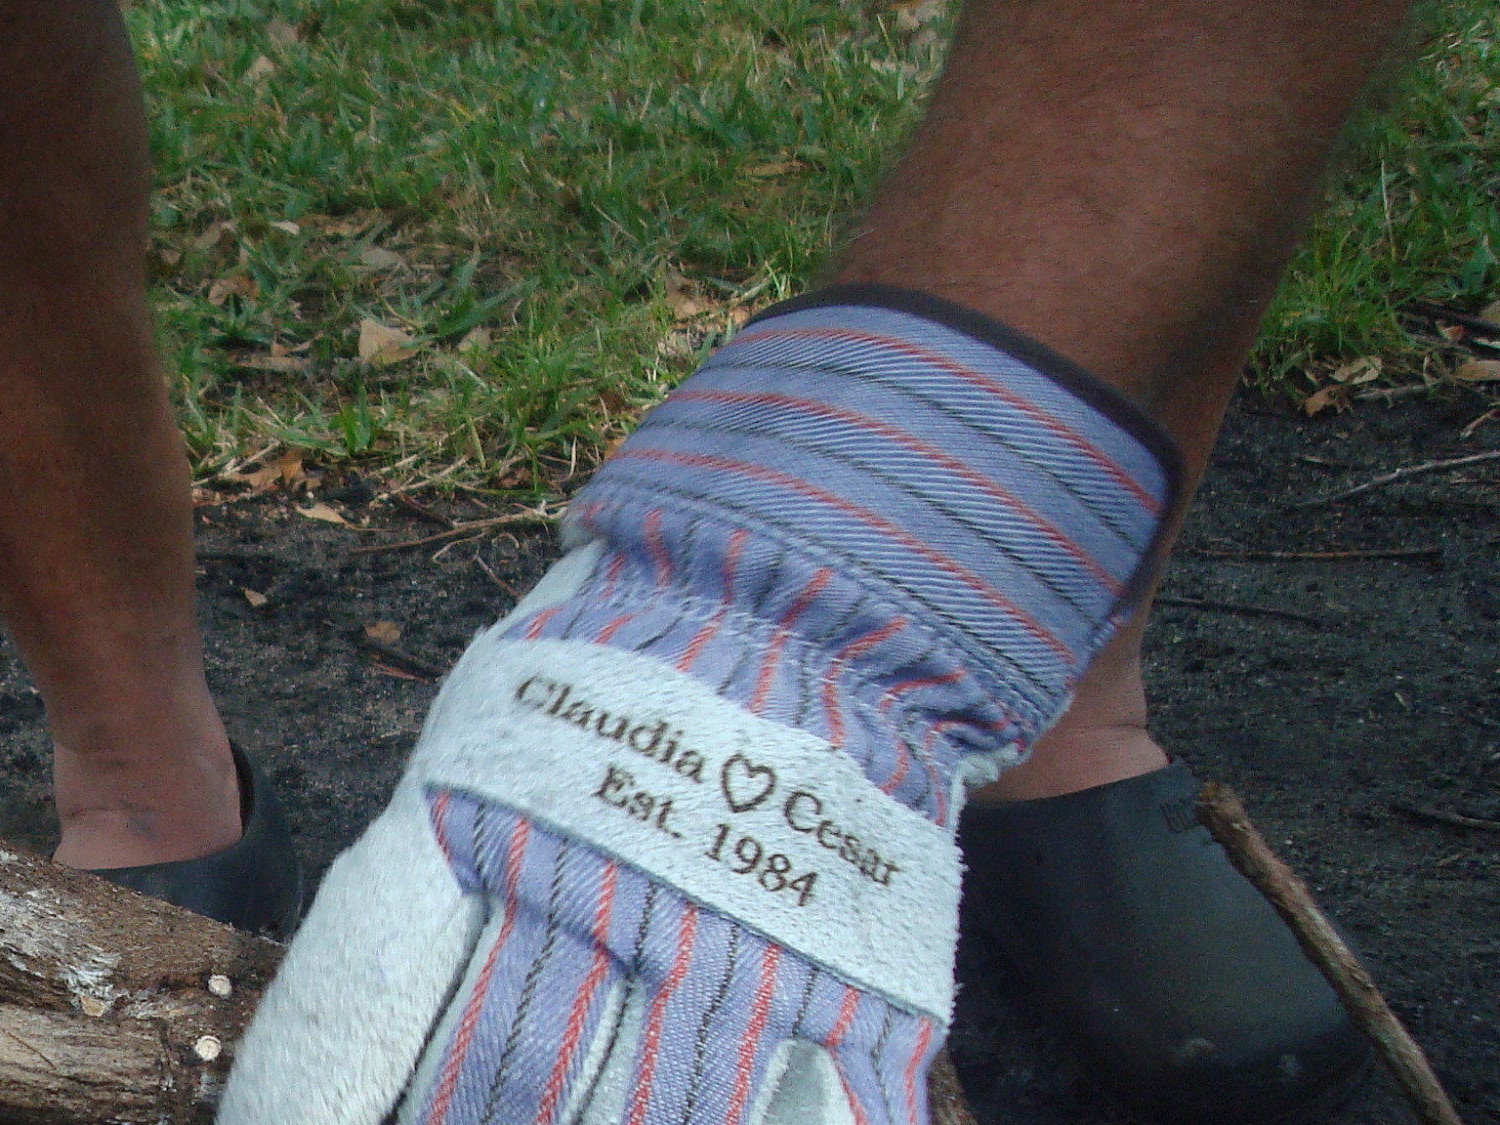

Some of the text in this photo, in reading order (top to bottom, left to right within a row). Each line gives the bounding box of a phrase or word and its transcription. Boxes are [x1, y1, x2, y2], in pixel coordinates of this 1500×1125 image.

[516, 675, 902, 886] Claudia Cesar
[593, 764, 818, 906] Est. 1984
